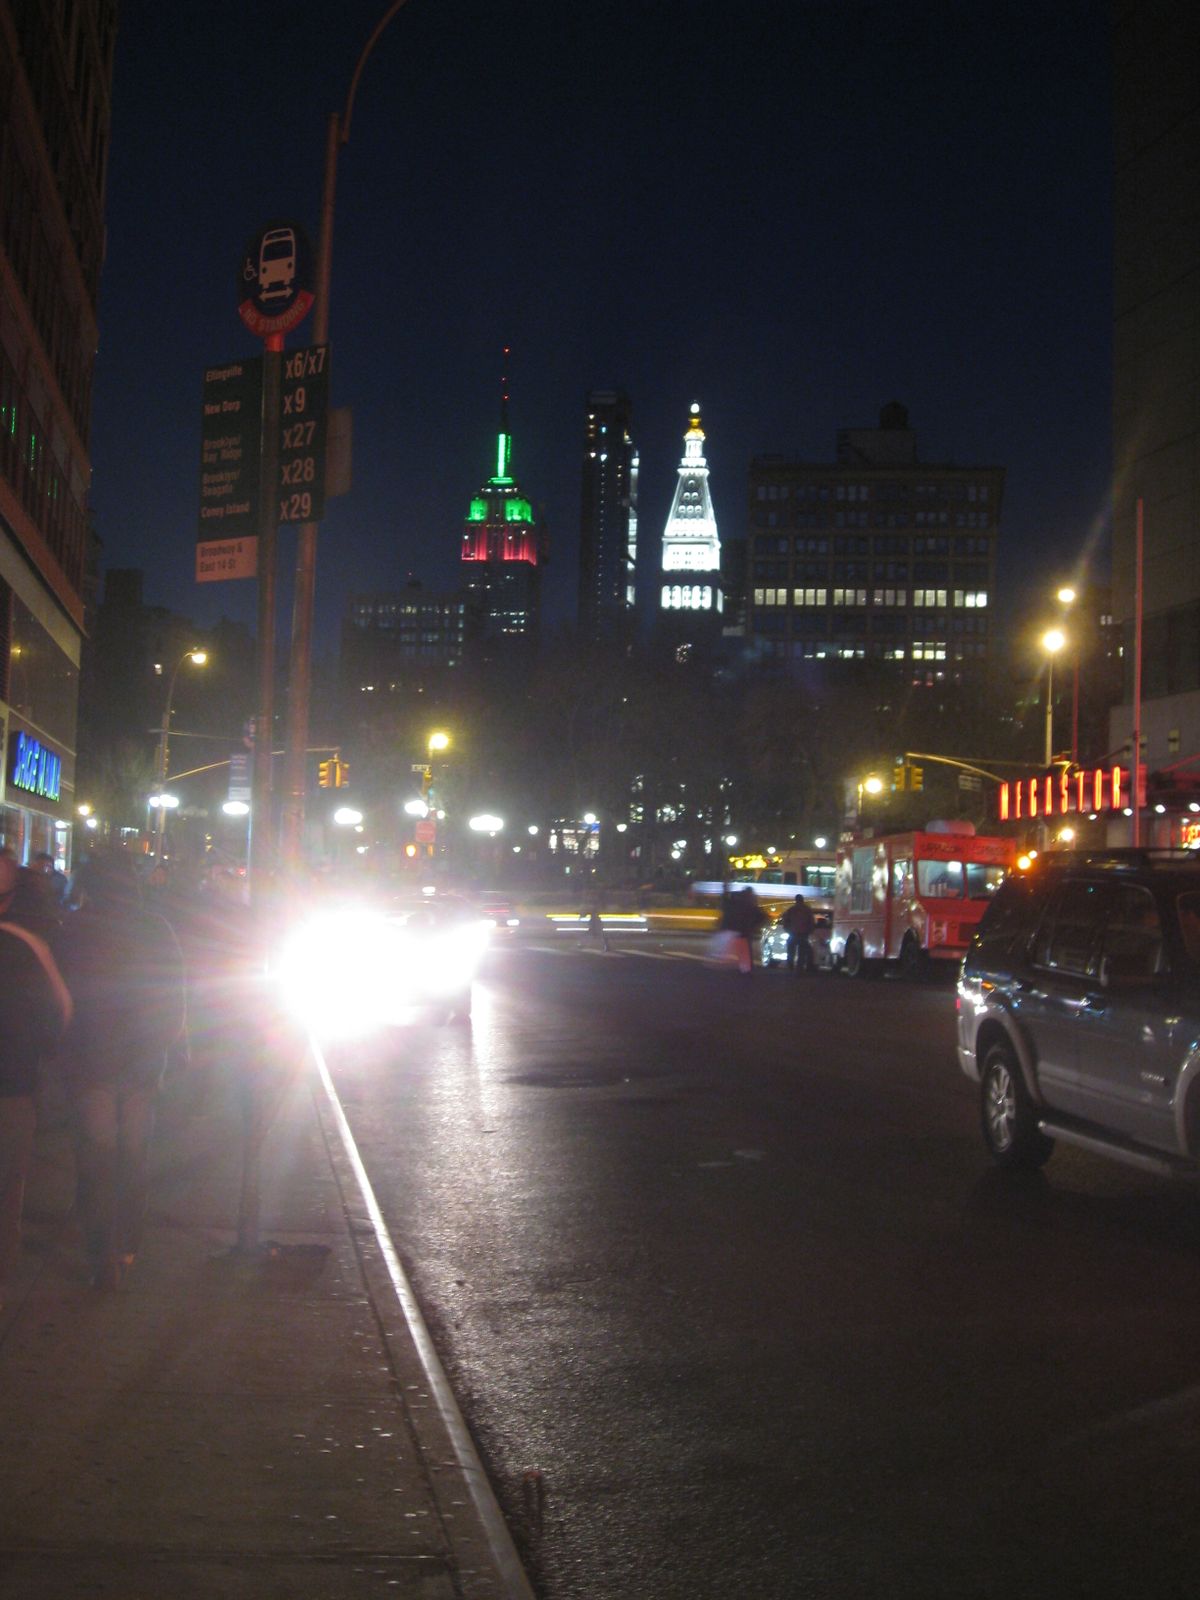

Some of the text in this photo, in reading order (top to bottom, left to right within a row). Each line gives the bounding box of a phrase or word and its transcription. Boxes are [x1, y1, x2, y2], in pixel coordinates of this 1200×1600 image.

[285, 347, 326, 380] x6/x7
[204, 400, 241, 416] New Dorp
[283, 387, 305, 415] x9
[283, 421, 316, 449] x27
[281, 457, 314, 485] x28
[201, 501, 250, 518] Coney Island
[280, 492, 312, 521] x29
[200, 560, 216, 572] East
[1000, 766, 1139, 821] MEGASTOR
